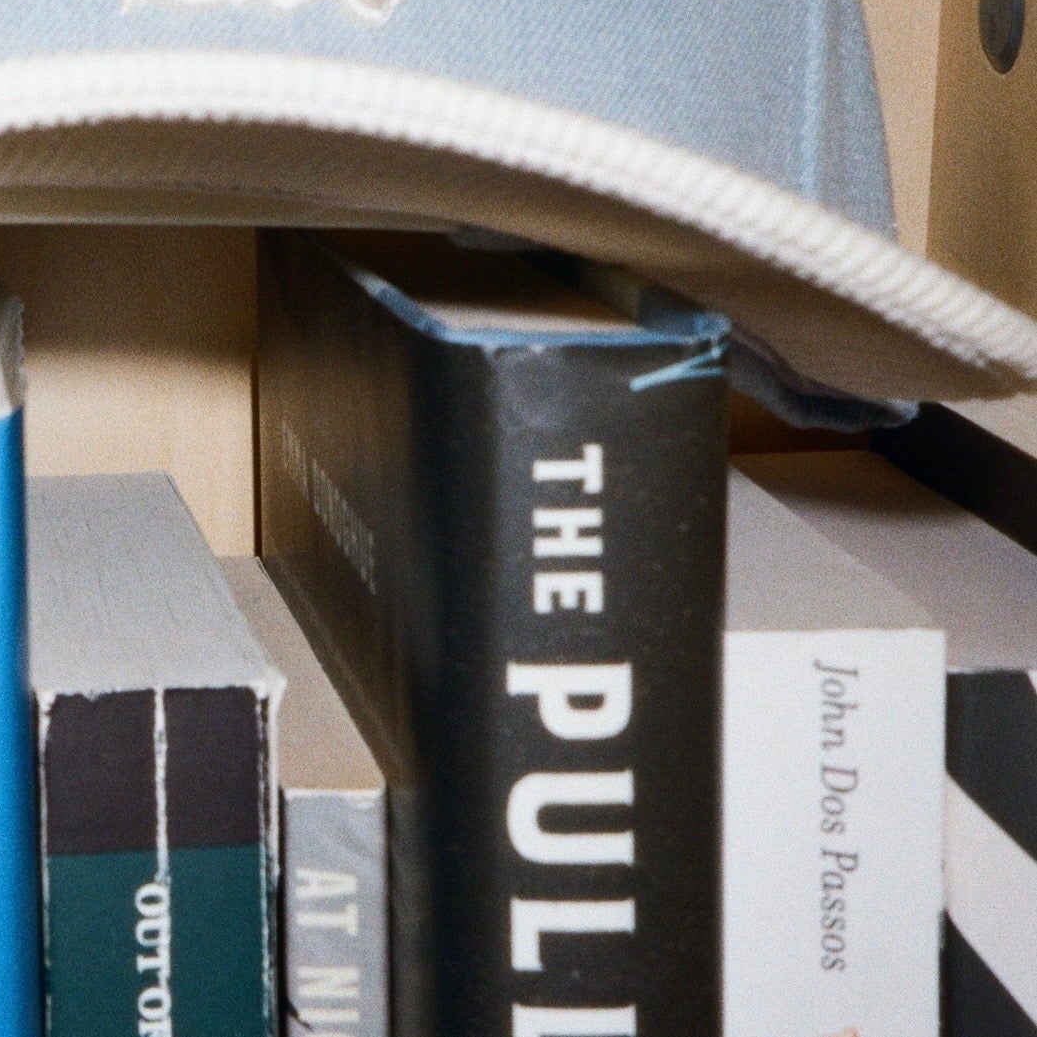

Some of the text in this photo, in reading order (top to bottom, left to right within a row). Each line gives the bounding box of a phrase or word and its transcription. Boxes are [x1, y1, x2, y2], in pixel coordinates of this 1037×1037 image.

[532, 444, 604, 614] THE
[814, 658, 860, 972] John Dos Passos
[295, 865, 362, 1037] AT NI
